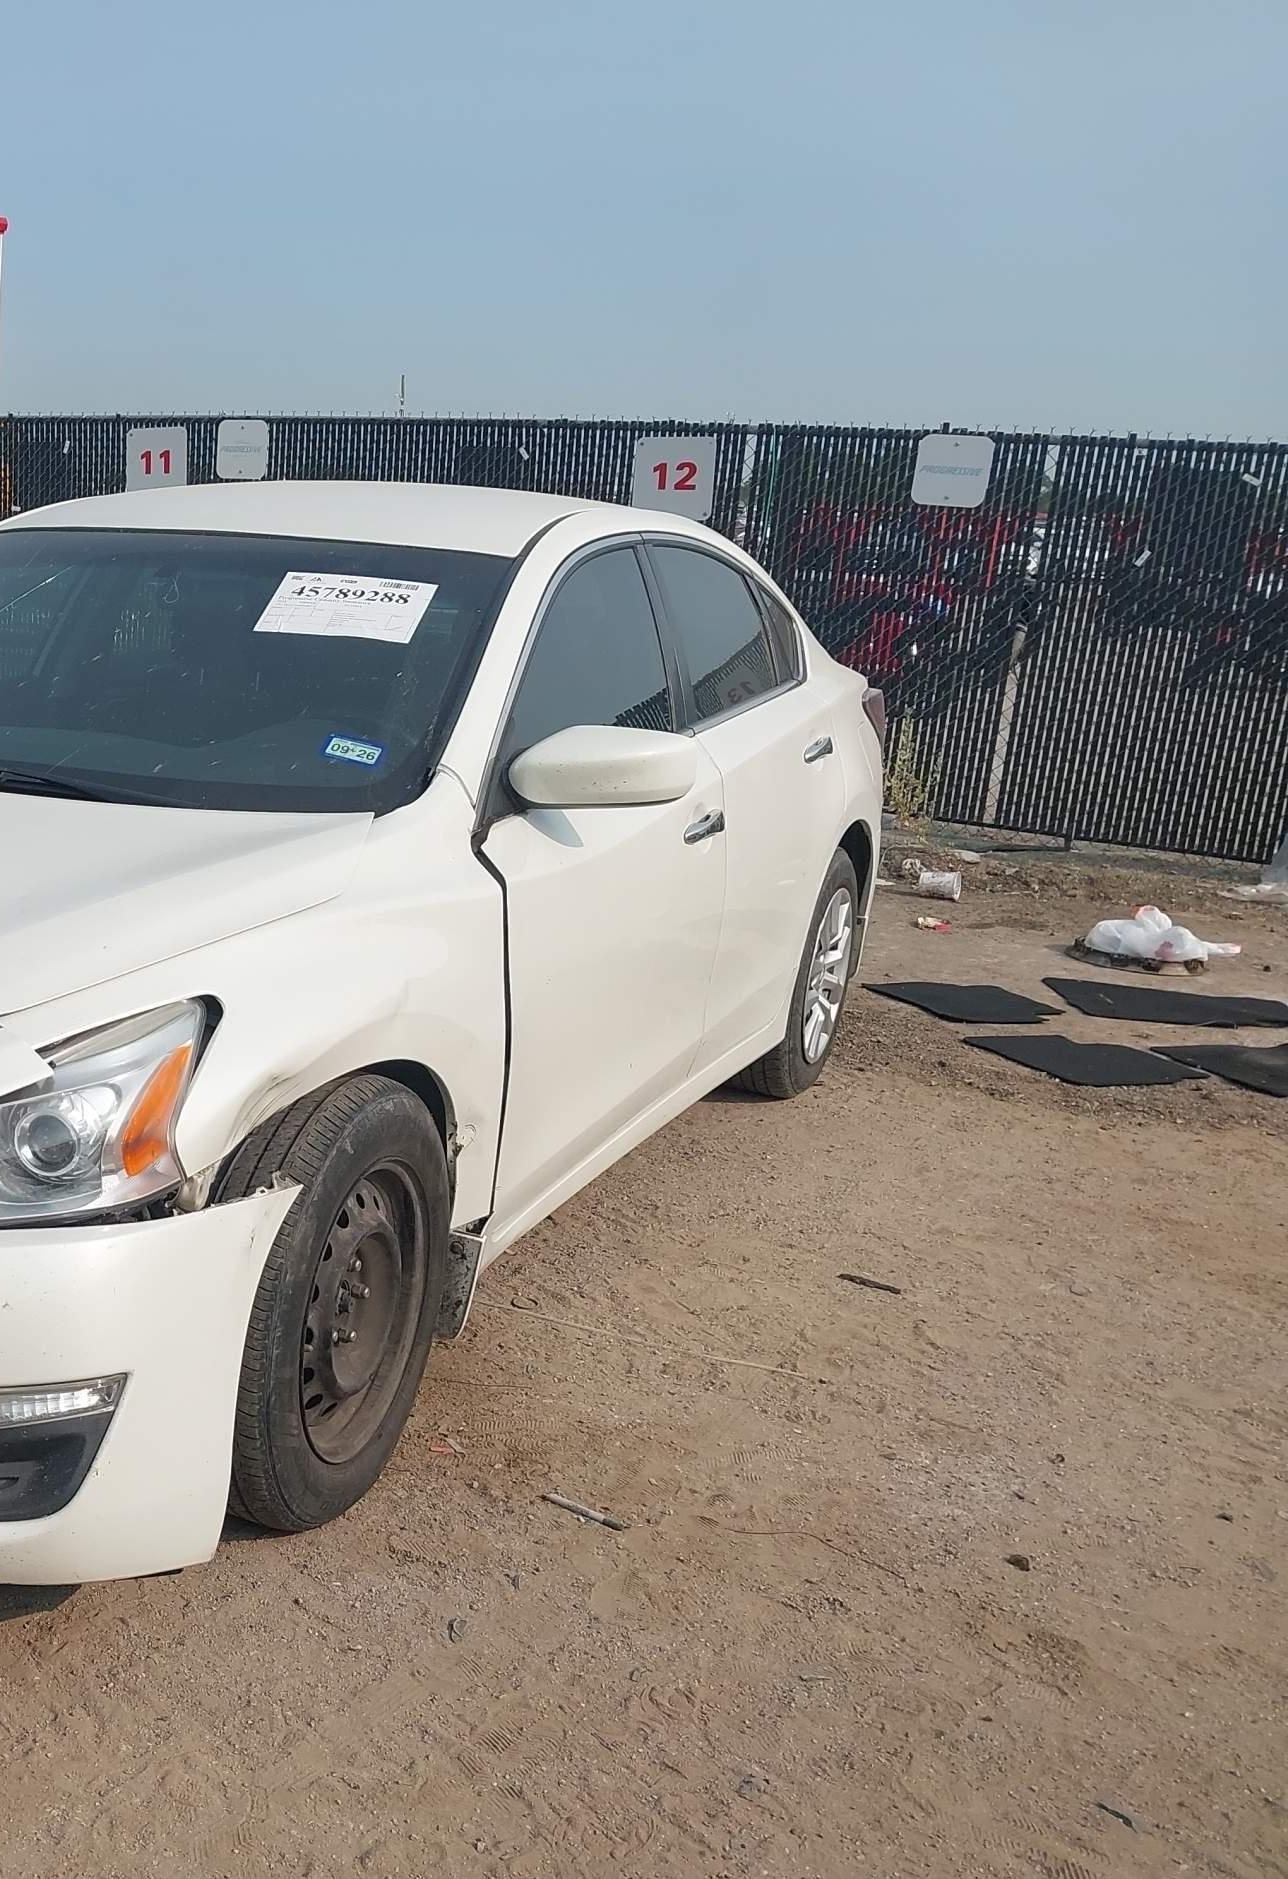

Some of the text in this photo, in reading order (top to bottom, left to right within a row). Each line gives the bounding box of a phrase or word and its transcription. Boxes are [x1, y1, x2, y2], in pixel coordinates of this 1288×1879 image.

[140, 449, 171, 475] 11
[652, 462, 698, 491] 12
[291, 585, 412, 605] 45789288
